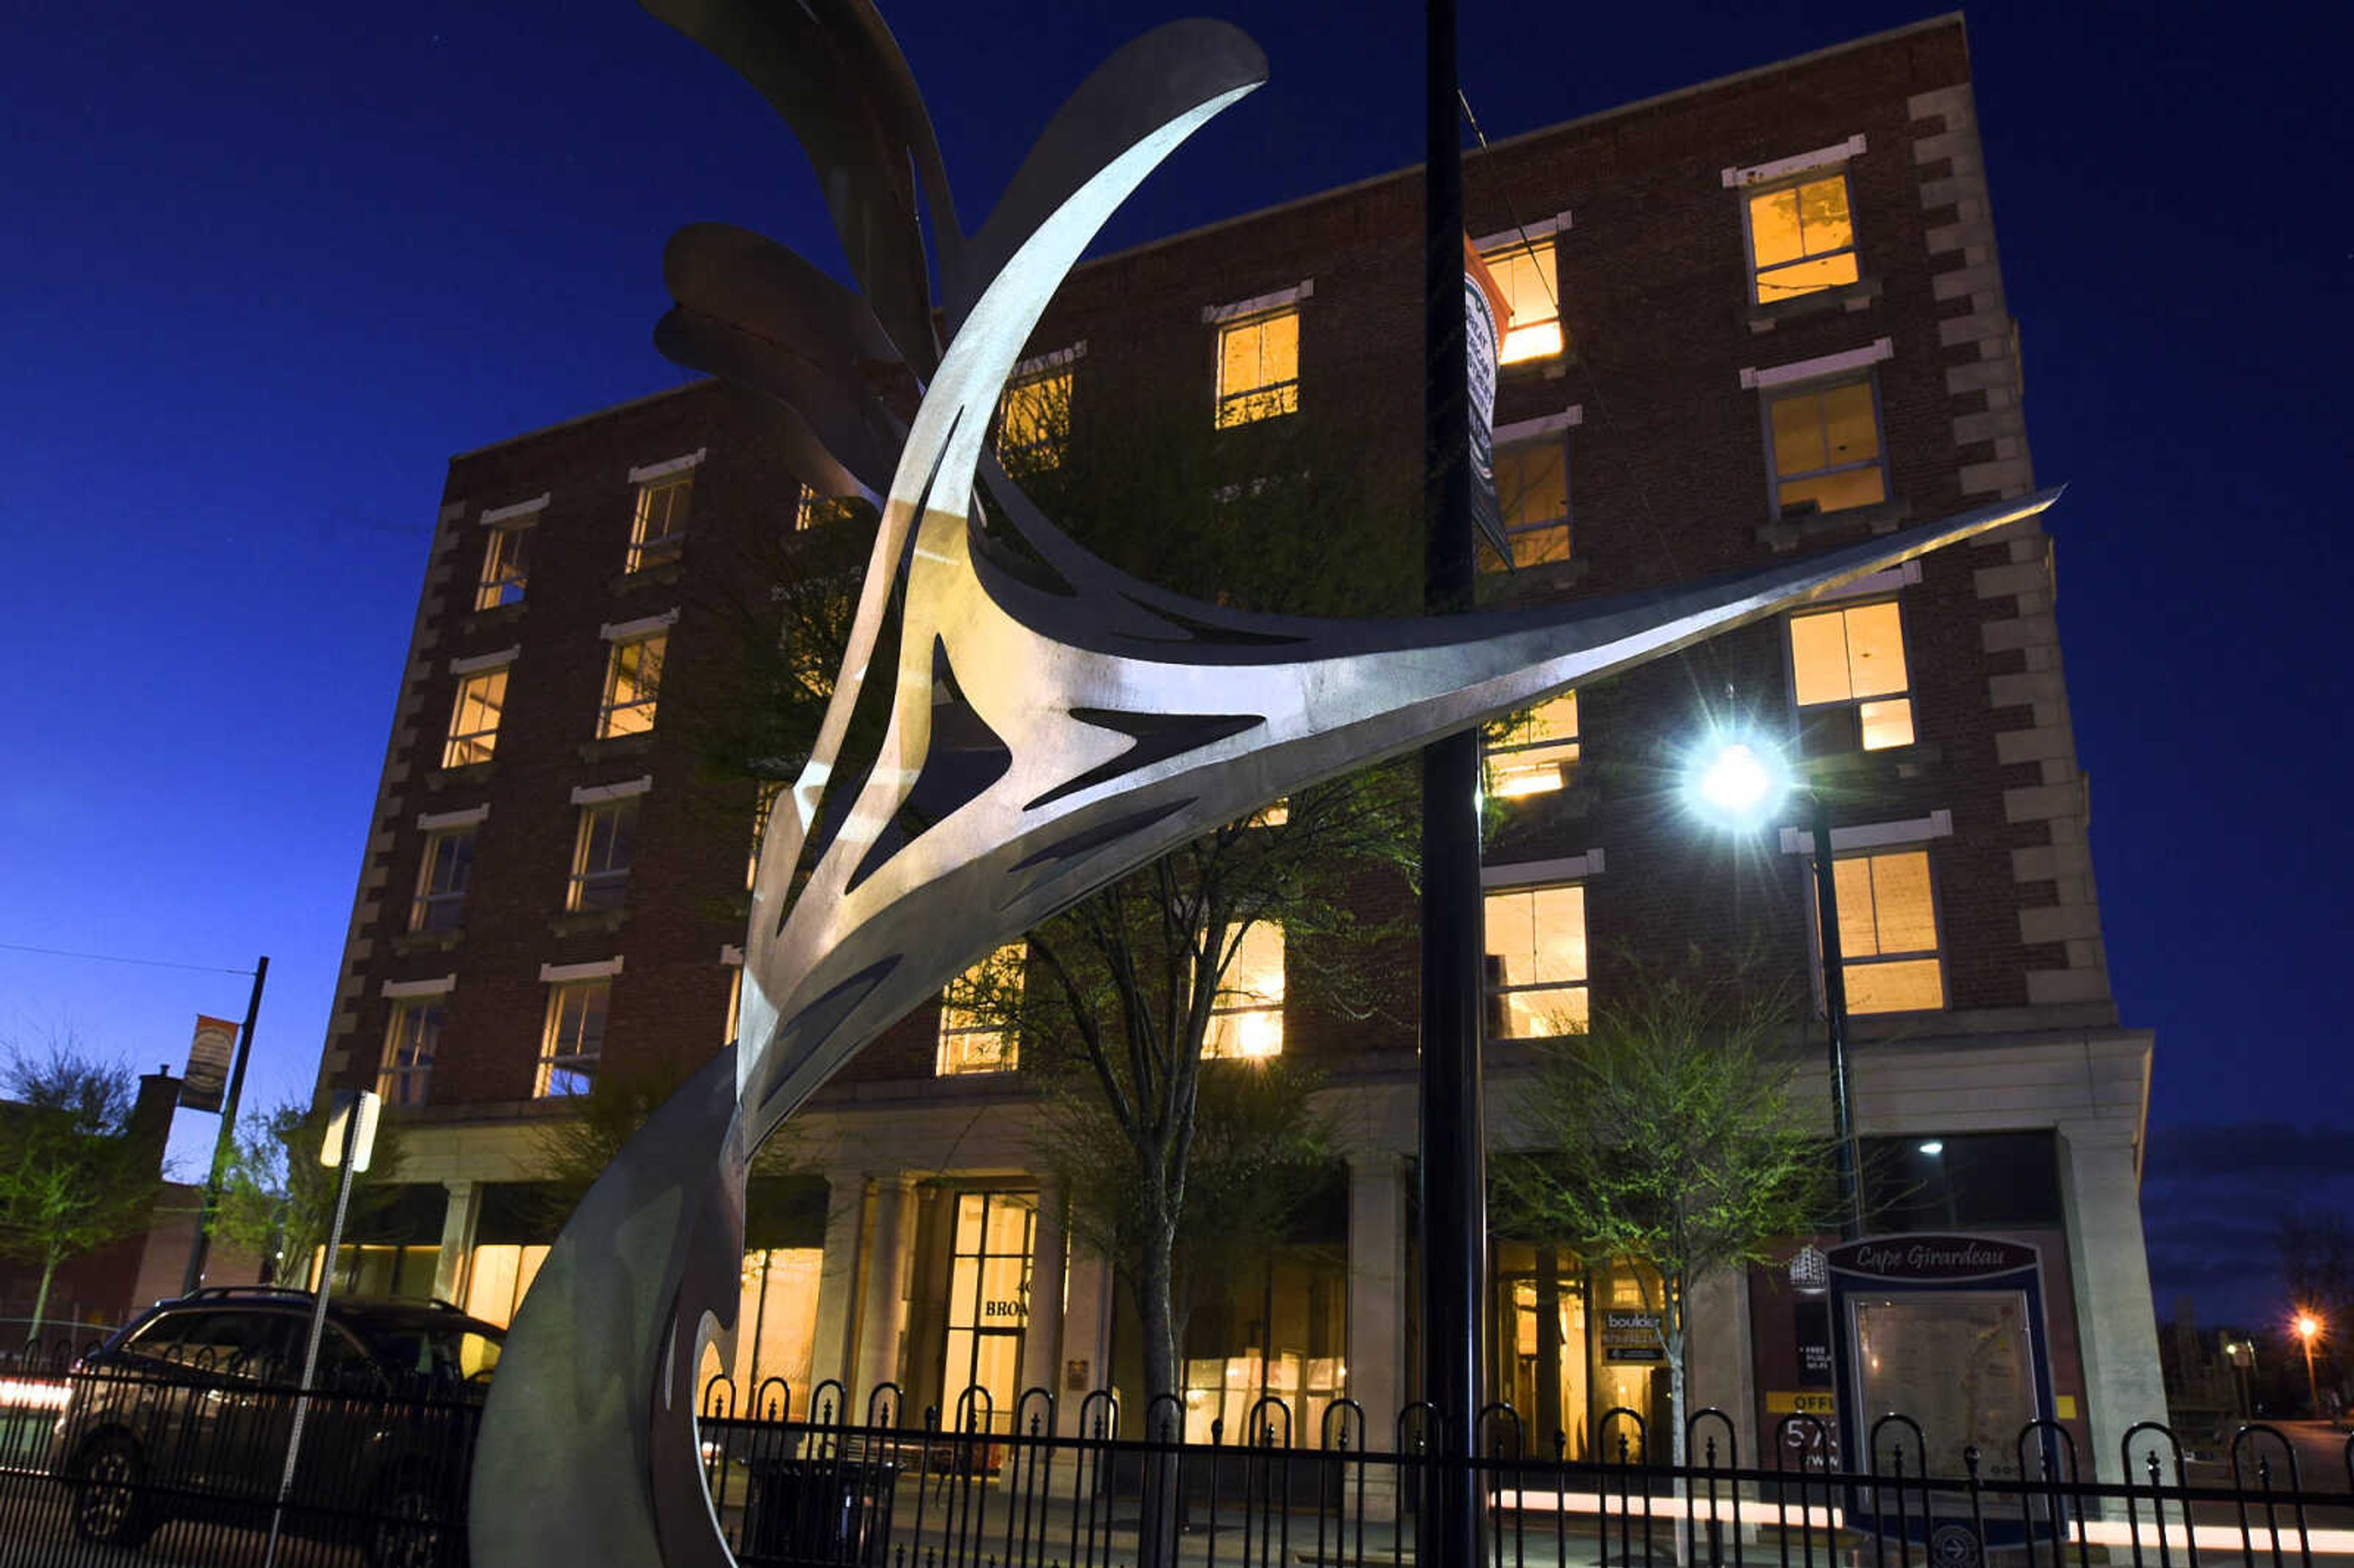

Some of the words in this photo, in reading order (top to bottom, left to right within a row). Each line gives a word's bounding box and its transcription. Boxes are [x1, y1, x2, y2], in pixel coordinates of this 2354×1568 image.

[1857, 1246, 1902, 1273] Cape
[1906, 1241, 2004, 1268] Girardeau
[986, 1301, 1028, 1317] BROA
[1608, 1313, 1661, 1328] boulder
